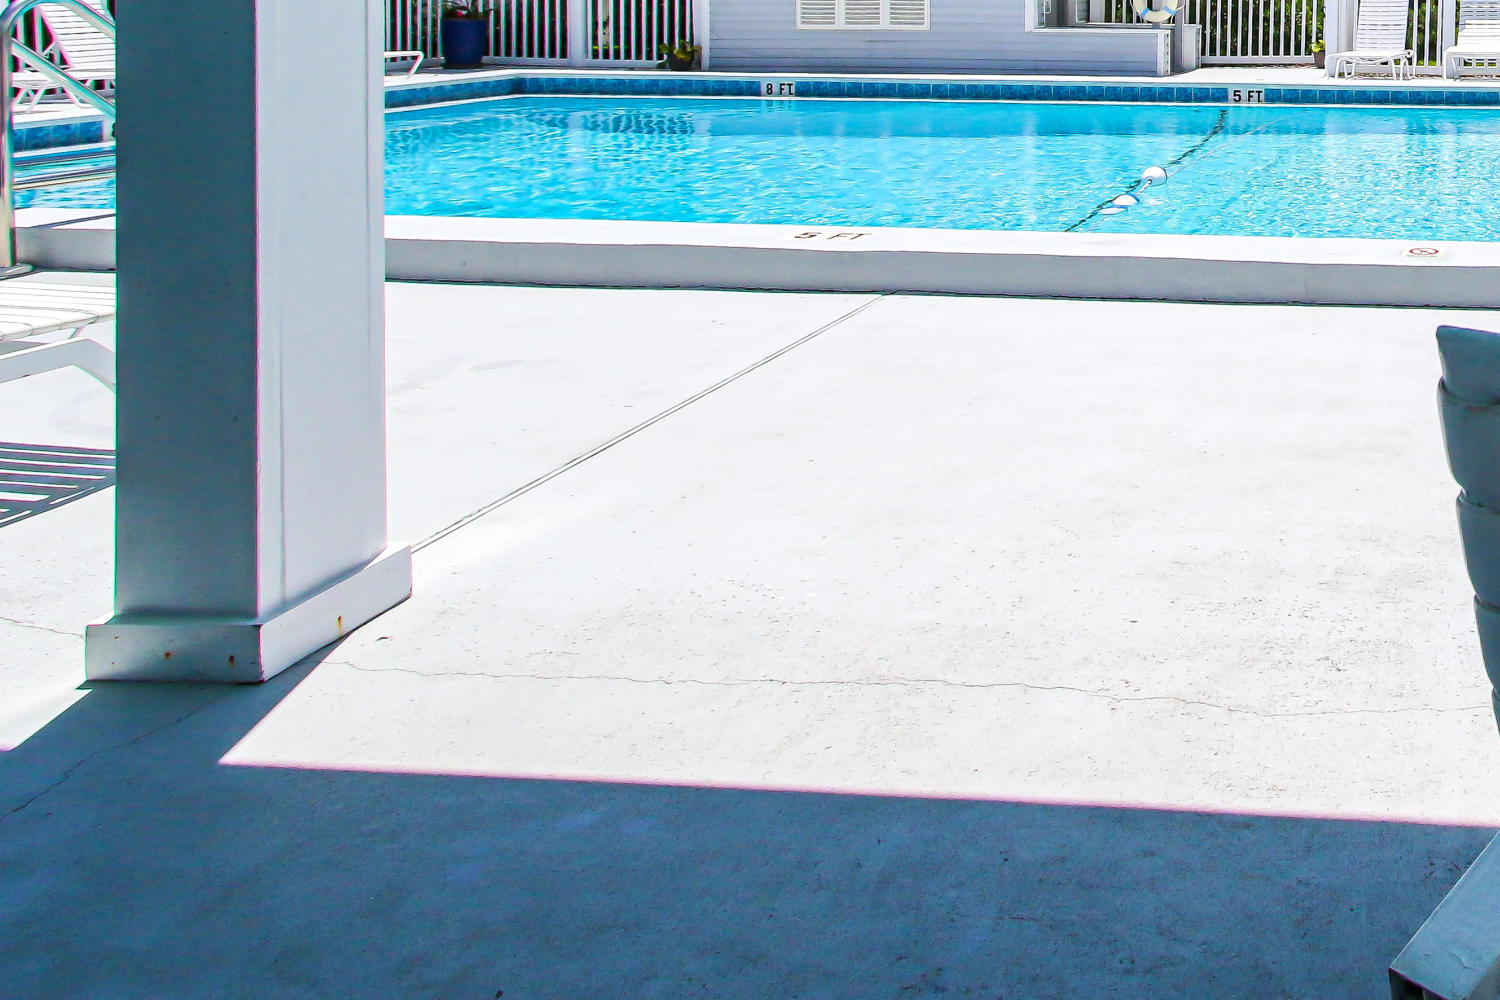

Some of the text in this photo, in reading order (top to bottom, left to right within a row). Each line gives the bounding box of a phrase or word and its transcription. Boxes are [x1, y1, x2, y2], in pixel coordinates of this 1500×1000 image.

[766, 83, 794, 95] 8 FT
[1233, 90, 1263, 102] 5 FT
[827, 232, 873, 241] FT
